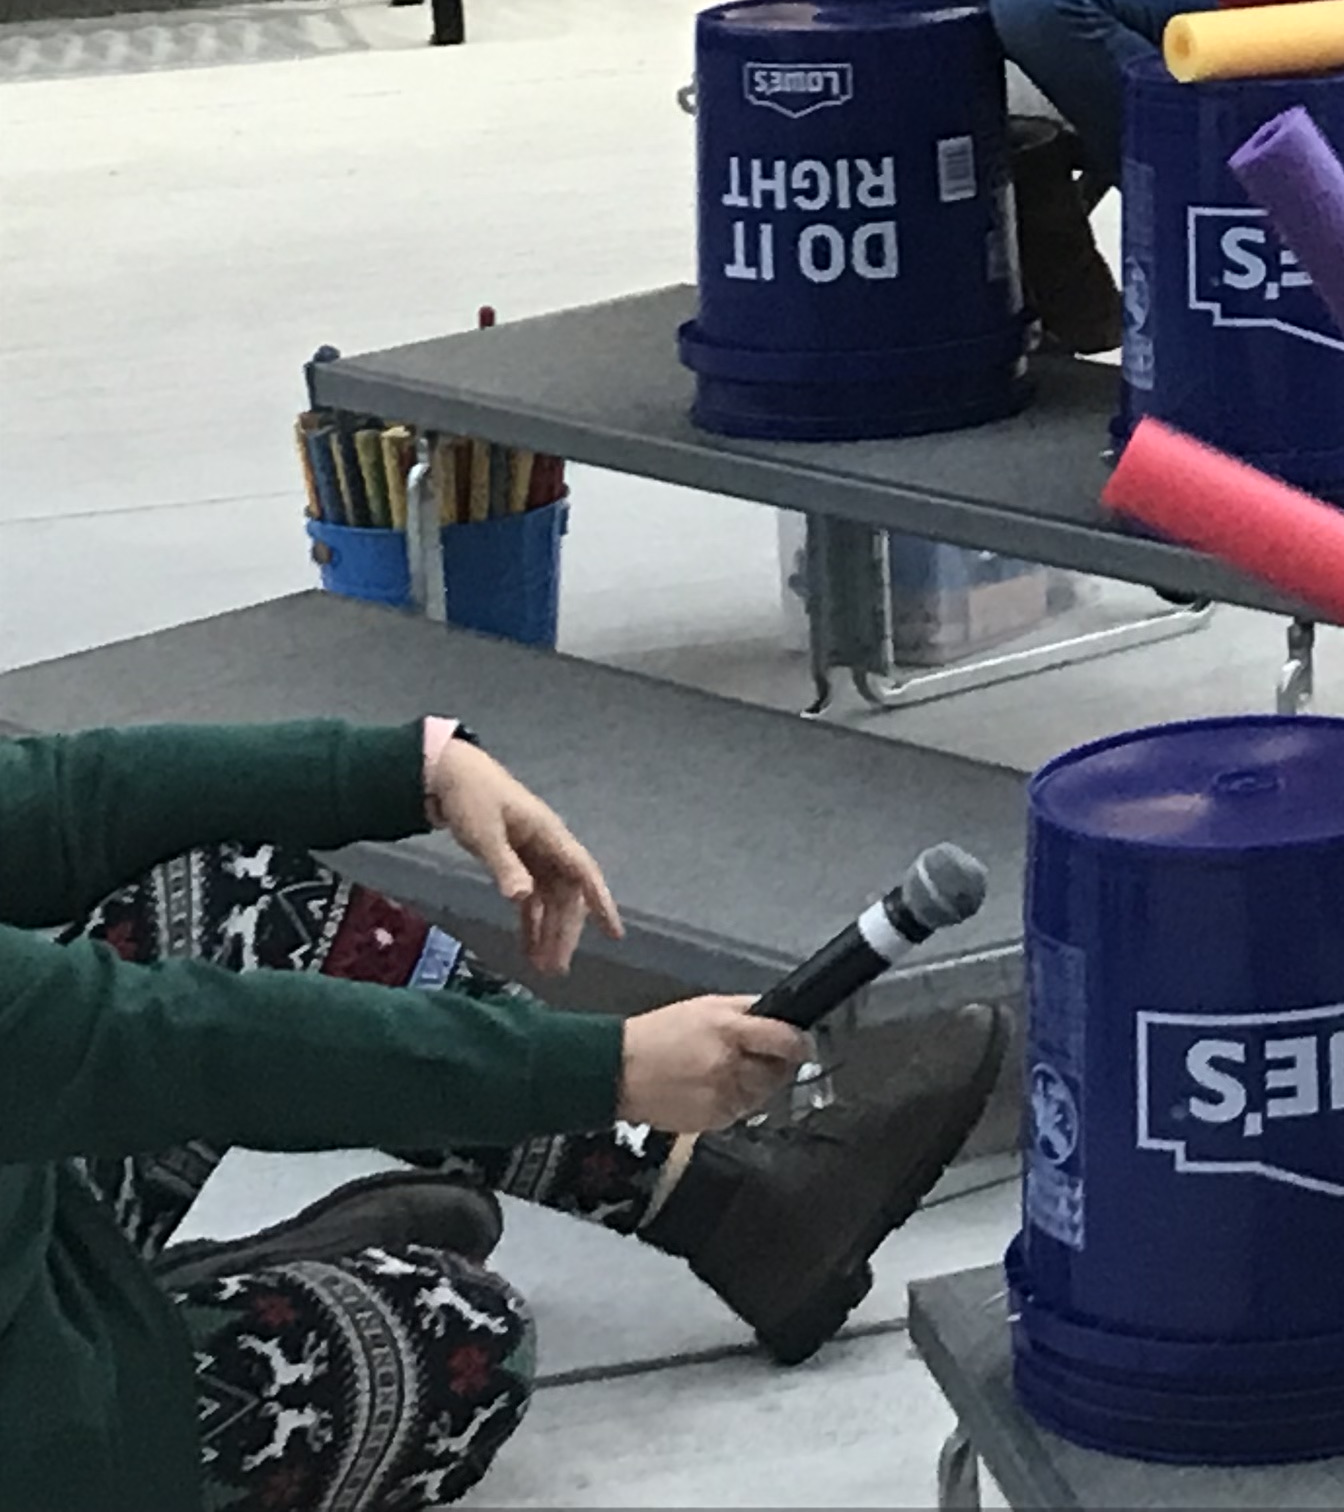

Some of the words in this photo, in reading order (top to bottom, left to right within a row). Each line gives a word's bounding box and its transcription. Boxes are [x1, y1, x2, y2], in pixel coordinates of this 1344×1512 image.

[754, 71, 839, 95] LOWE'S
[722, 154, 895, 211] RIGHT
[723, 221, 774, 282] IT
[798, 220, 899, 283] DO
